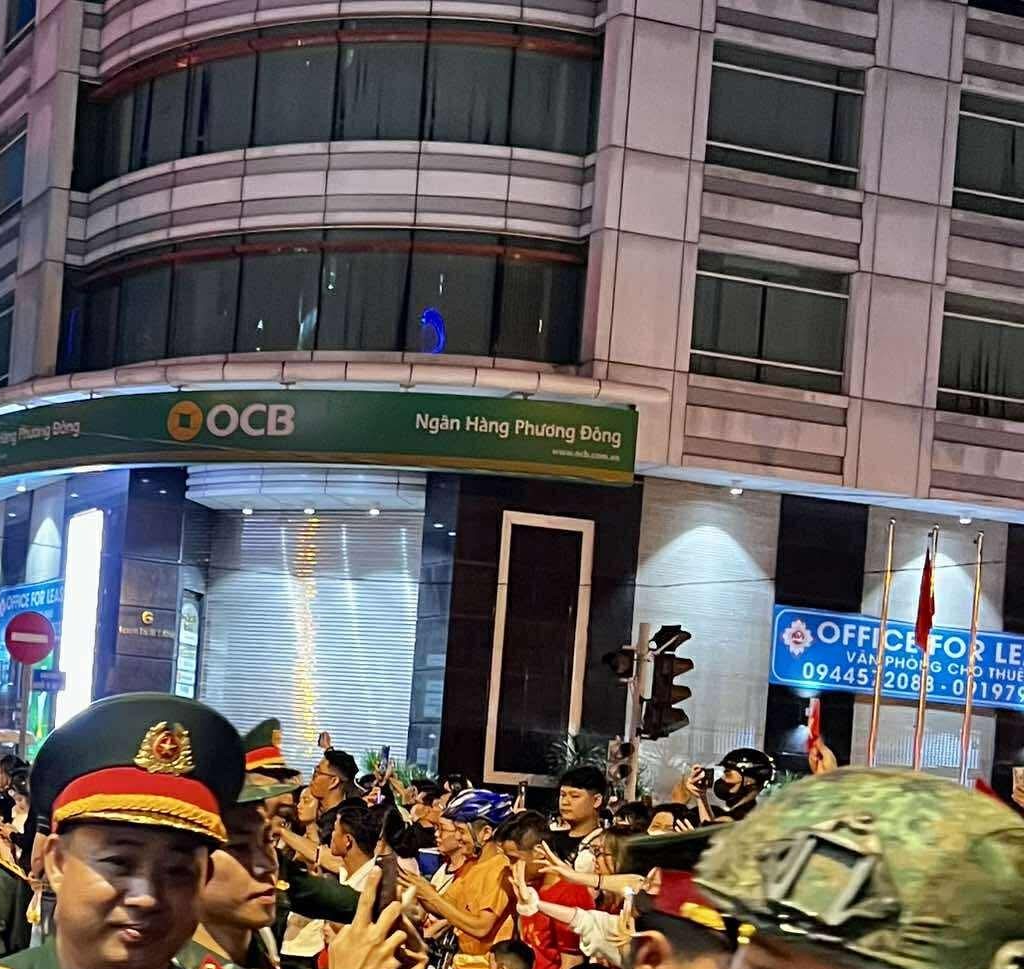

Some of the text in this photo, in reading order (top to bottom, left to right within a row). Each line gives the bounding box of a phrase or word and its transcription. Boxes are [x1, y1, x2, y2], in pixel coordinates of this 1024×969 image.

[206, 402, 295, 436] OCB
[415, 413, 622, 447] Ngân Hàng Phương Đông
[30, 590, 46, 606] FOR
[46, 585, 65, 604] LEAS
[817, 621, 1024, 666] OFFICE FOR LE
[947, 662, 983, 678] CHO
[952, 679, 1024, 702] 01979
